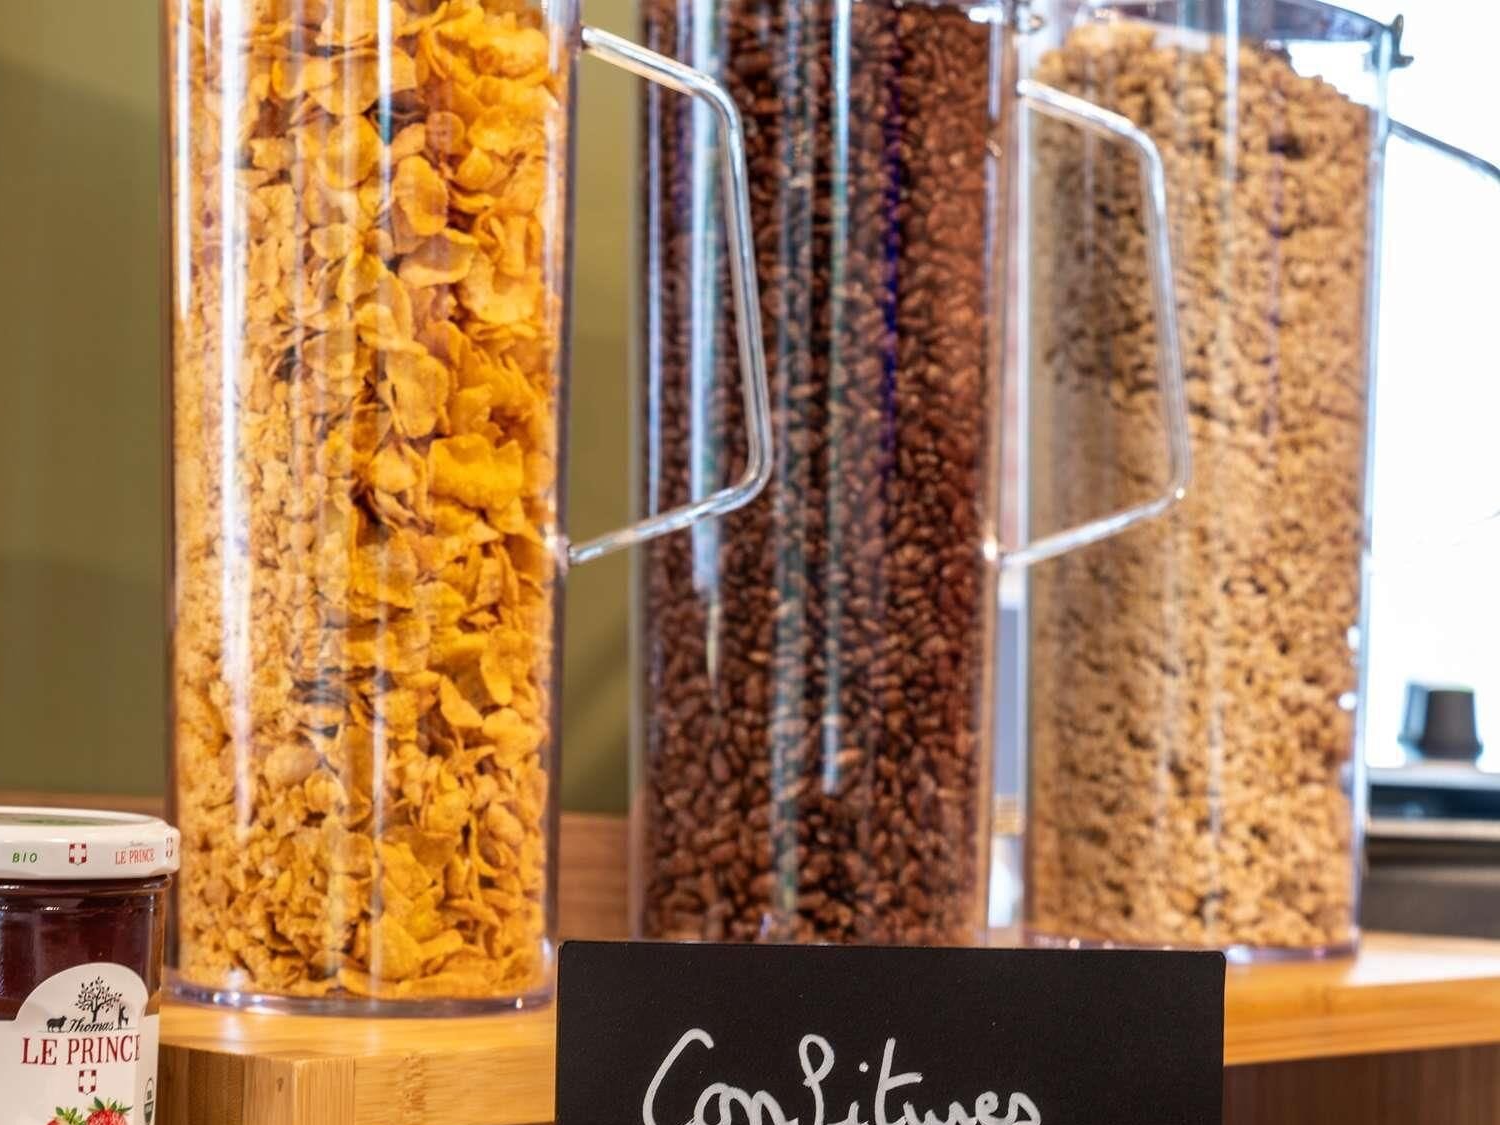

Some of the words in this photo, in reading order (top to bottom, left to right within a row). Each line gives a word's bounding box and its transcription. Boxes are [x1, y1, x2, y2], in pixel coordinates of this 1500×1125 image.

[12, 852, 38, 864] BIO
[115, 851, 126, 865] LE
[68, 1017, 114, 1032] Thomas
[21, 1037, 58, 1065] LE
[66, 1034, 140, 1065] PRINCE
